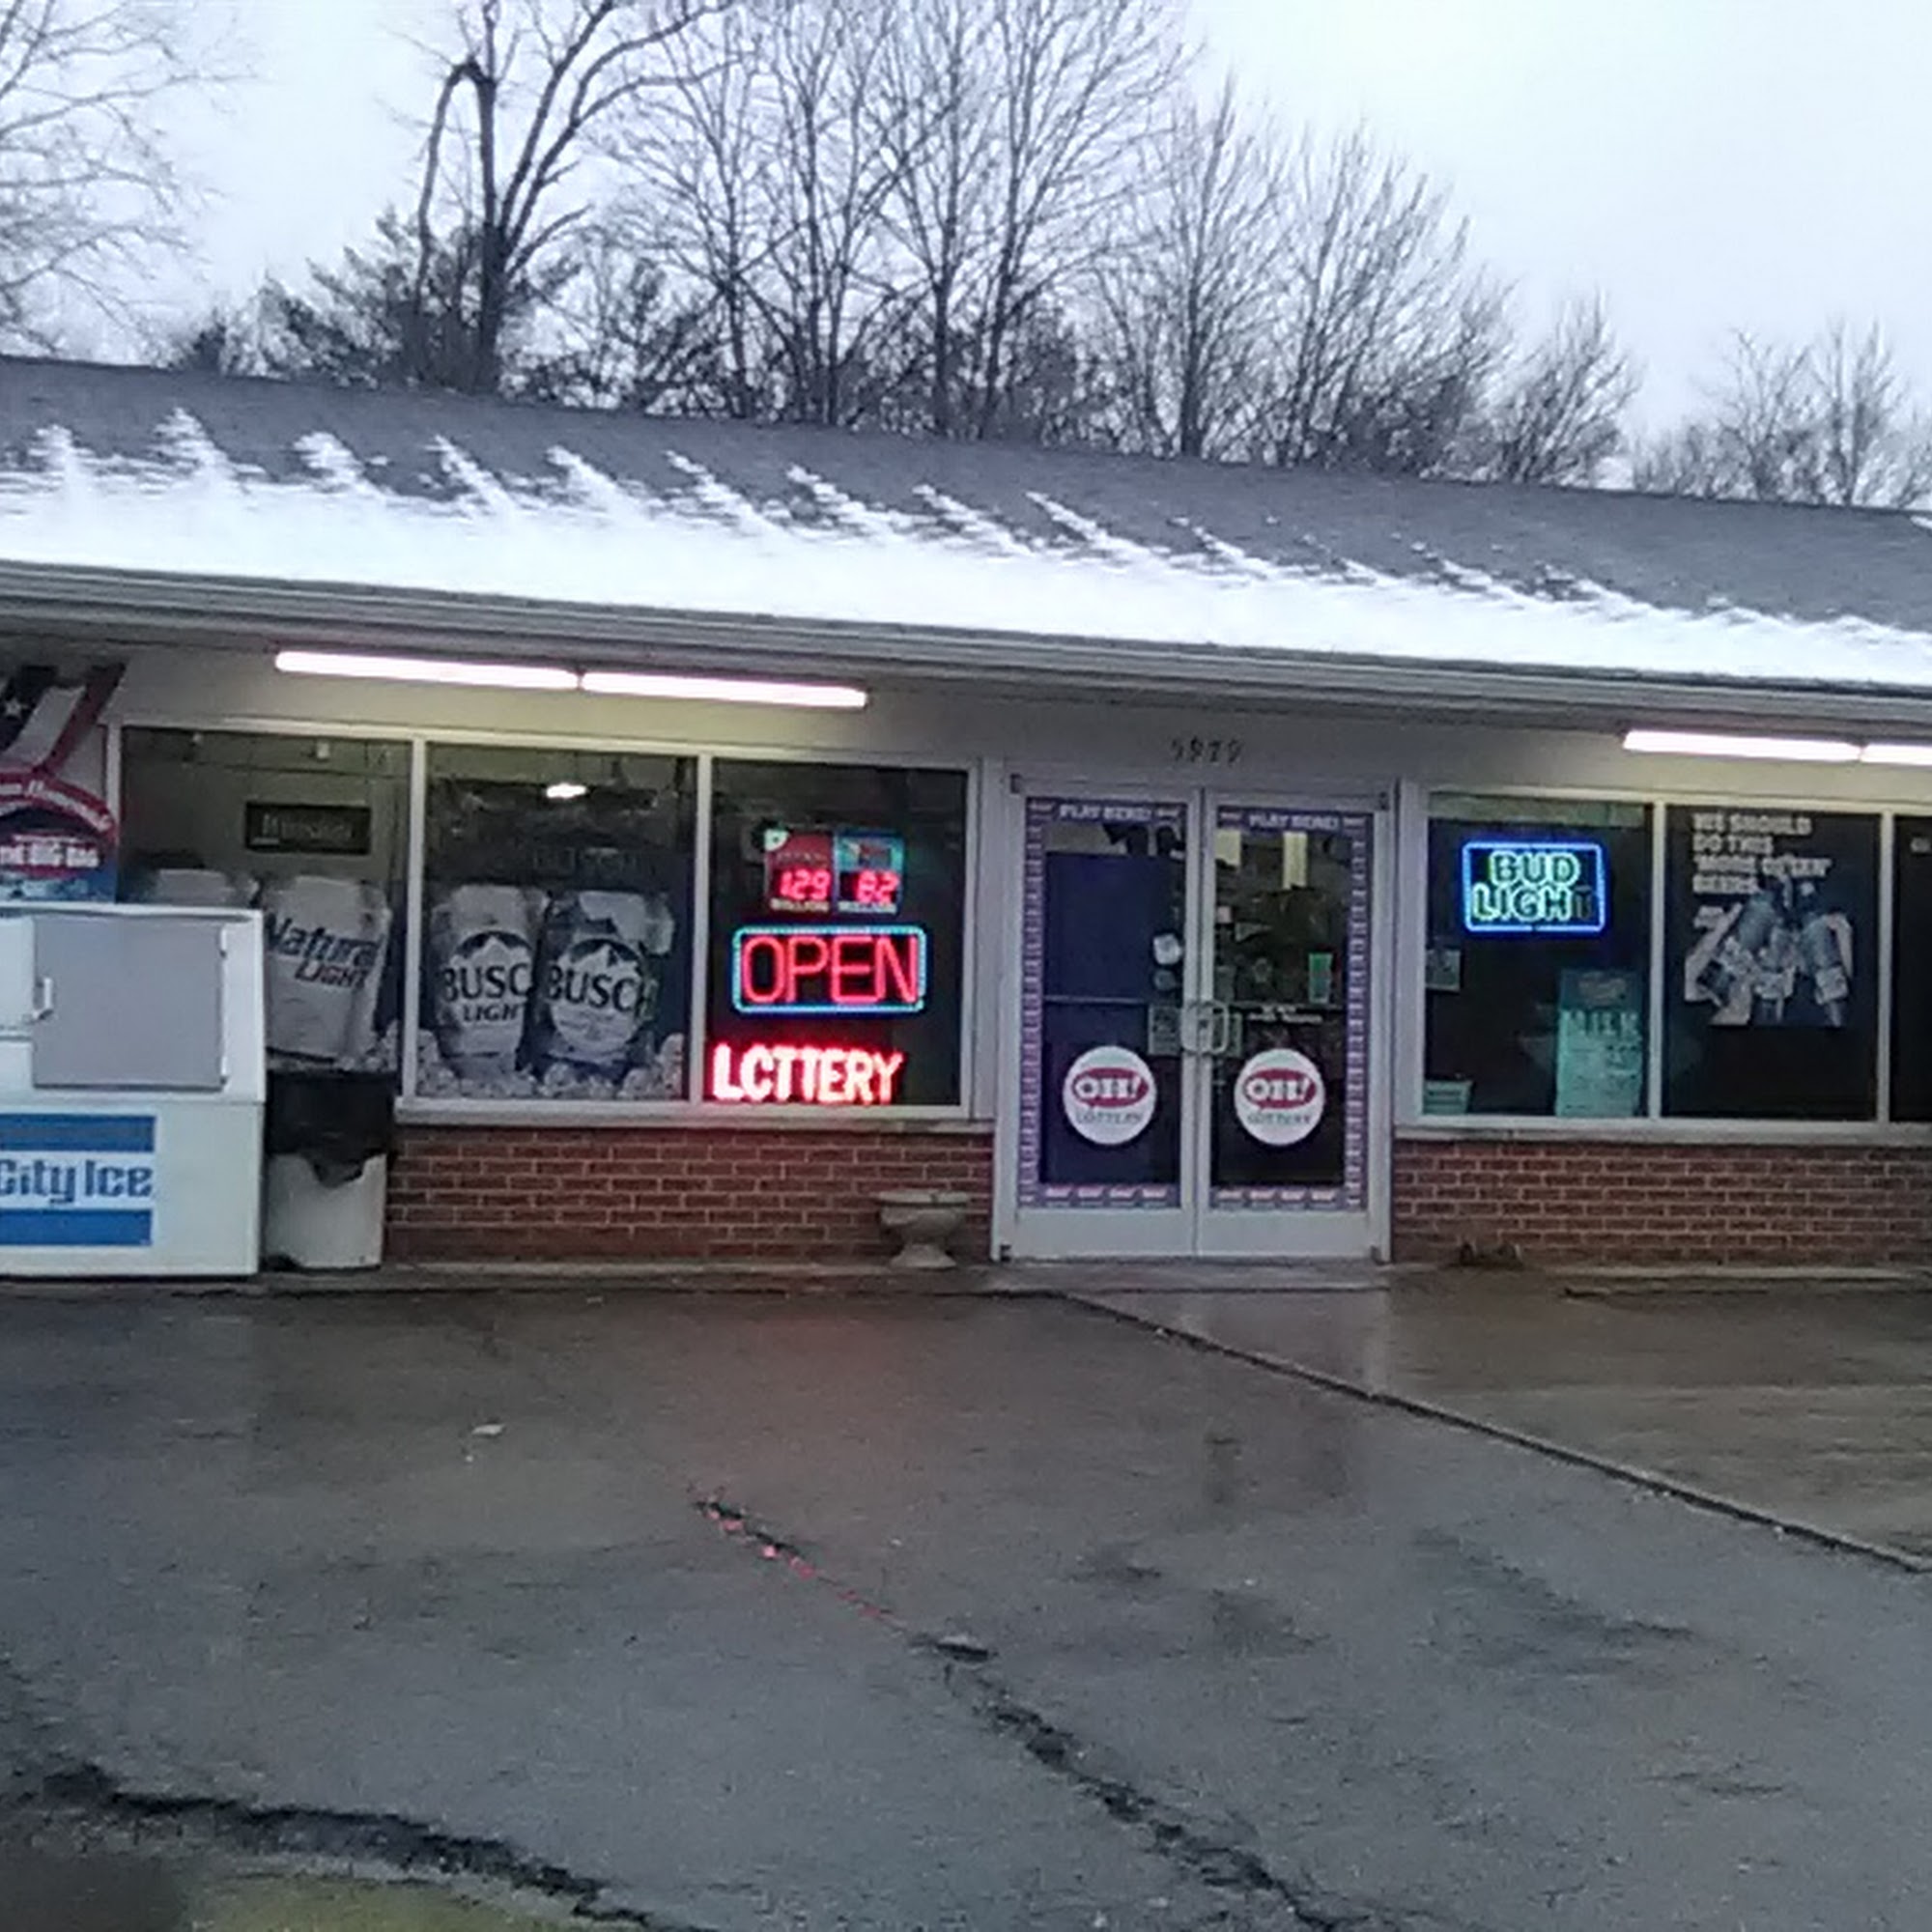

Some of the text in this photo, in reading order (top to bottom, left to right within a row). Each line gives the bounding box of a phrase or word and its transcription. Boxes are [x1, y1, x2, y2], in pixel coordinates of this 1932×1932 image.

[780, 868, 831, 902] 129
[1489, 850, 1581, 887] BUD
[1472, 883, 1594, 922] LIGHT
[442, 962, 533, 1003] BUSC
[741, 934, 918, 1004] OPEN
[712, 1042, 904, 1105] LOTTERY
[0, 1159, 154, 1204] City Ice
